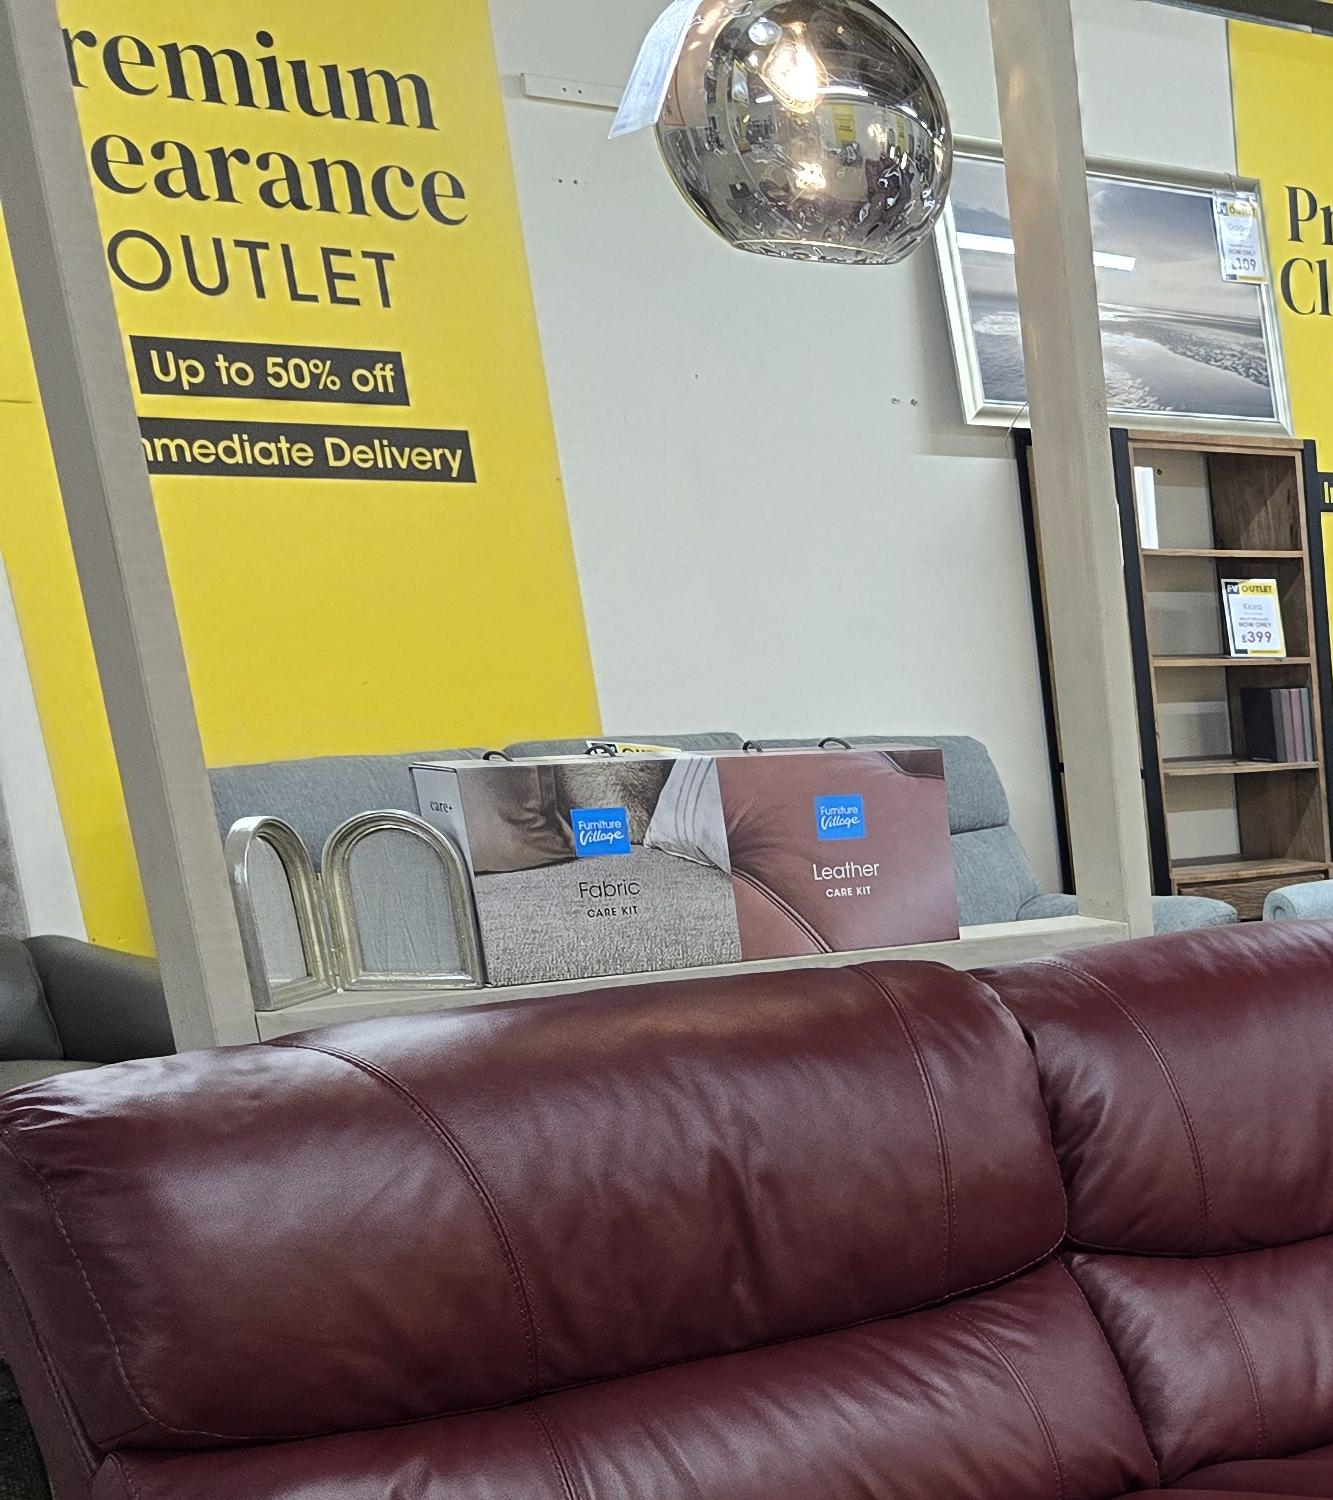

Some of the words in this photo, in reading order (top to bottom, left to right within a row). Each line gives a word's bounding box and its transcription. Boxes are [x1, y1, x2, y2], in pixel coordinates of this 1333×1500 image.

[62, 28, 439, 131] remium
[90, 133, 469, 226] earance
[107, 229, 395, 309] OUTLET
[149, 349, 205, 391] Up
[214, 353, 255, 386] to
[265, 356, 341, 391] 50%
[350, 363, 395, 393] off
[141, 433, 314, 467] mediate
[323, 436, 463, 478] Delivery
[1241, 585, 1273, 593] OUTLET
[1241, 631, 1272, 643] £399
[820, 806, 858, 815] Furniture
[578, 820, 621, 830] Furniture
[820, 815, 861, 831] Village
[579, 830, 625, 846] Village
[812, 861, 880, 880] Leather
[578, 879, 641, 899] Fabric
[825, 887, 853, 898] CARE
[856, 885, 871, 896] KIT
[587, 908, 617, 918] CARE
[621, 905, 638, 916] KIT
